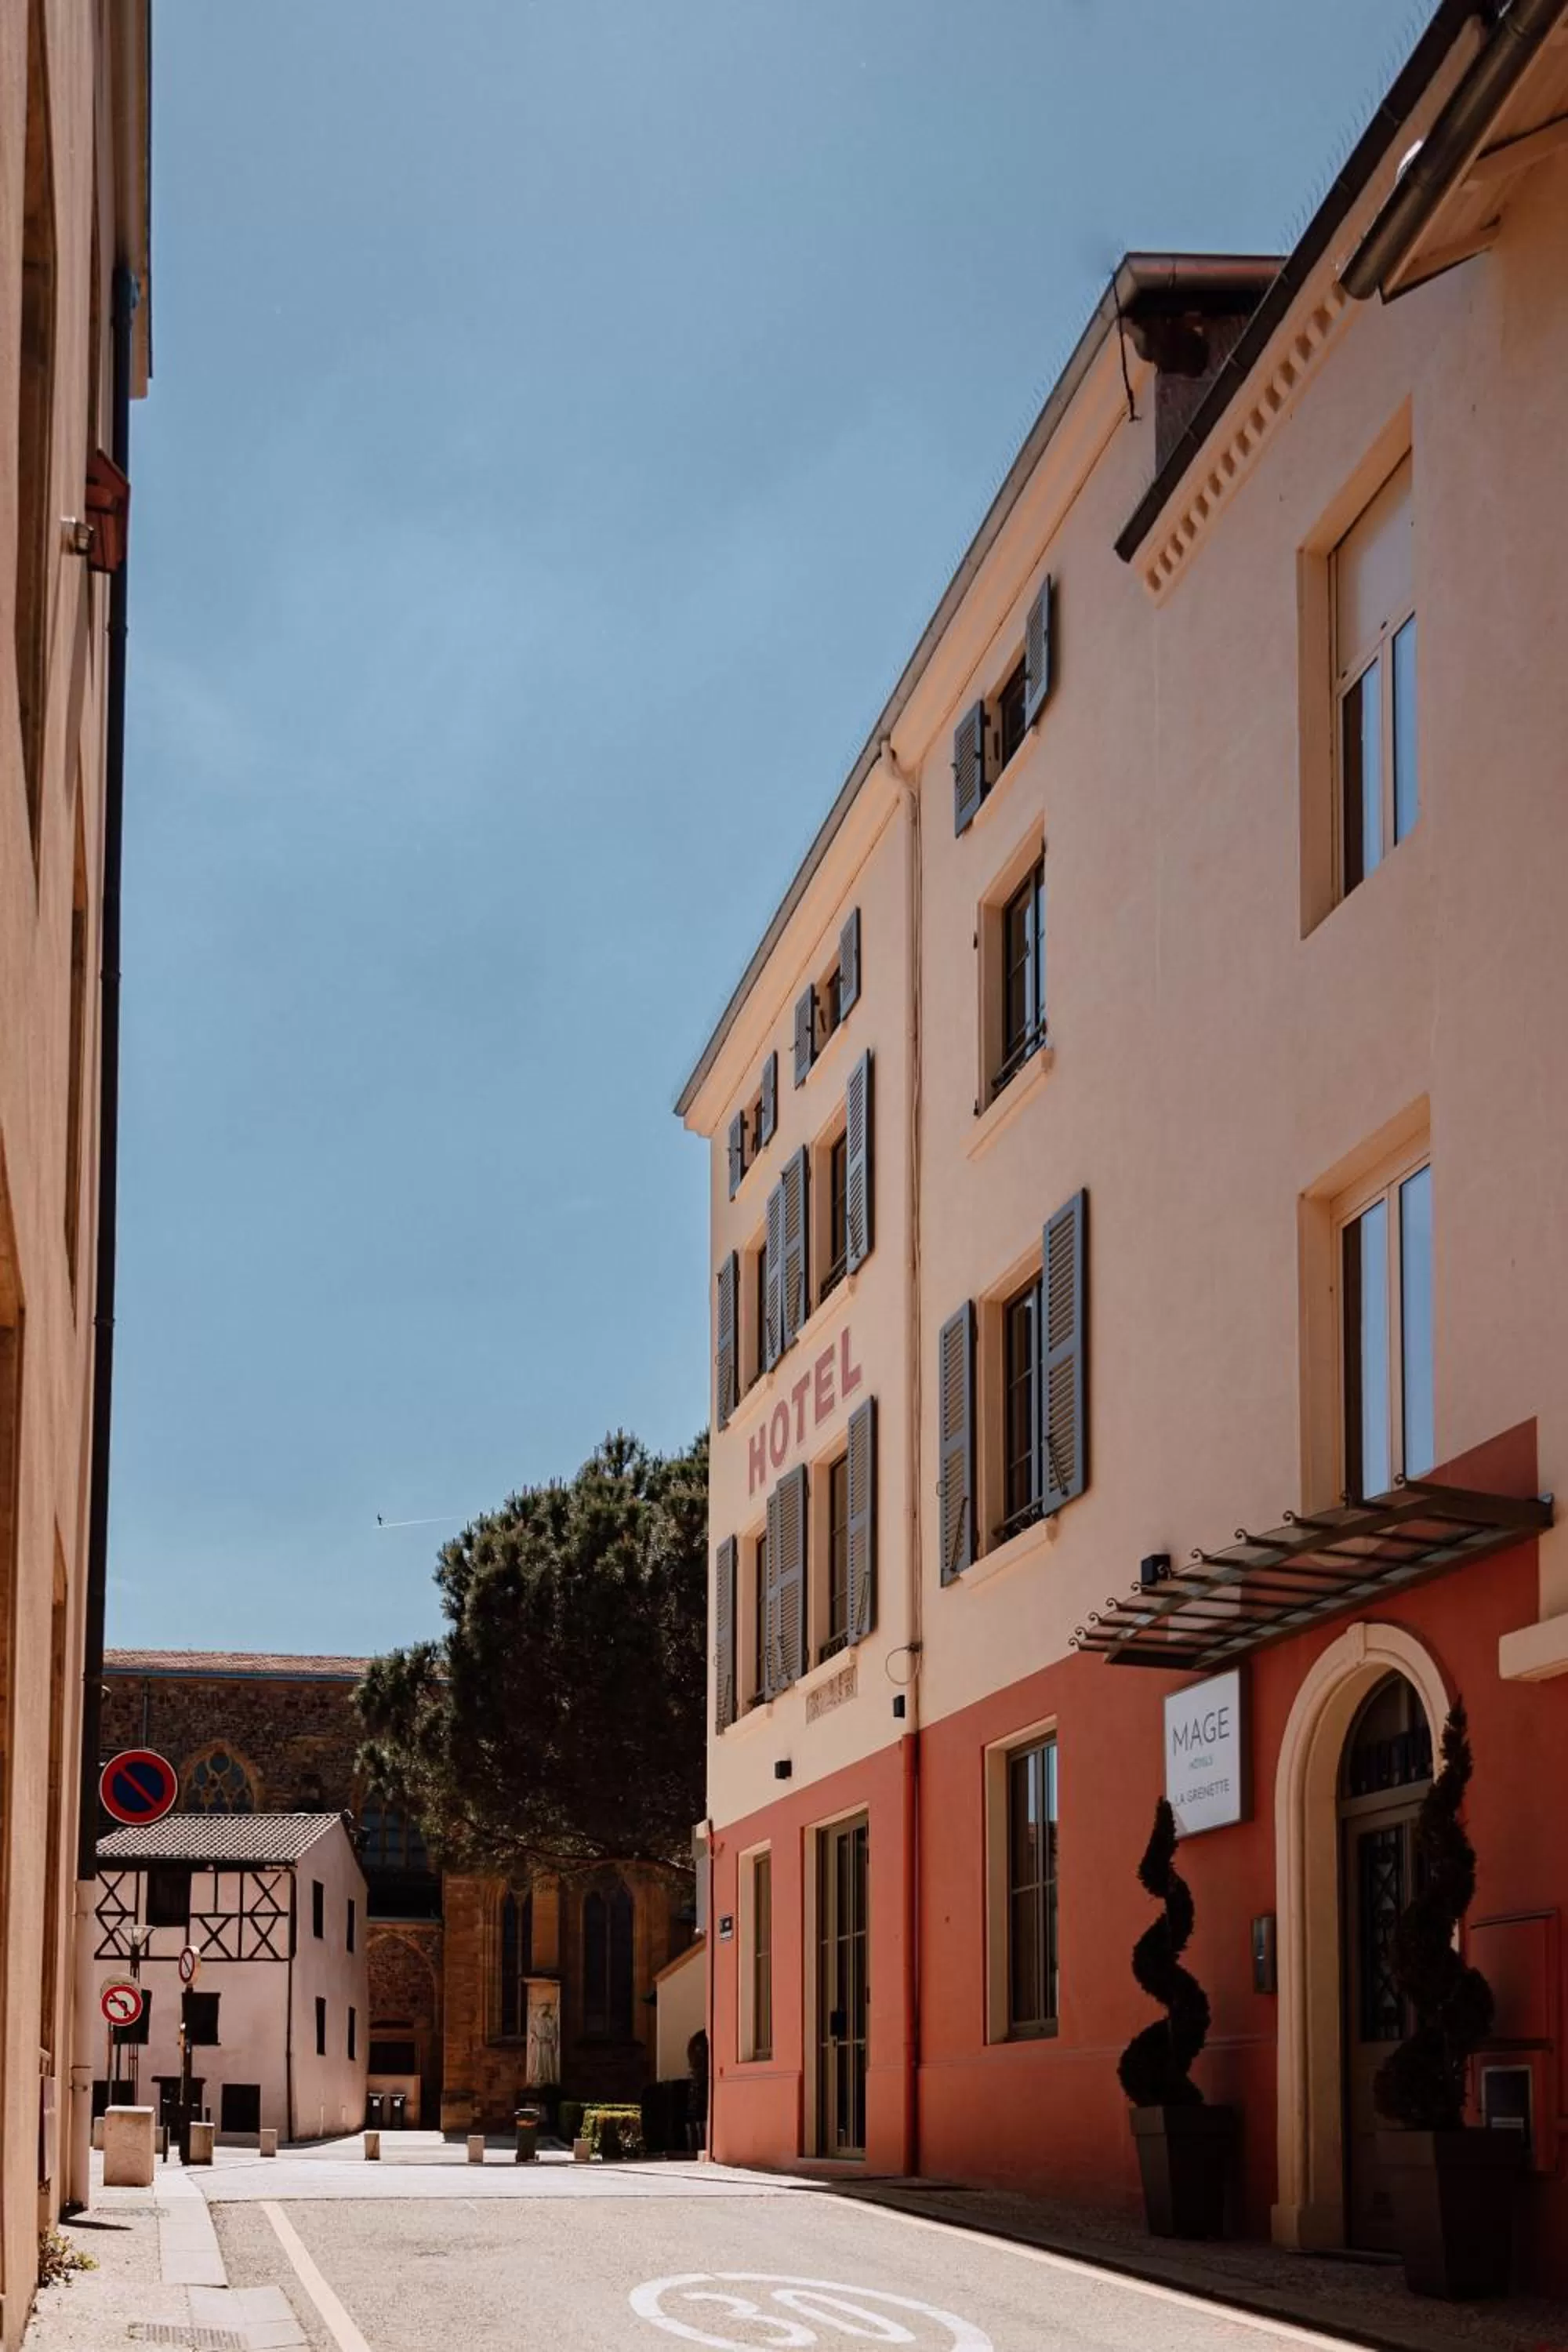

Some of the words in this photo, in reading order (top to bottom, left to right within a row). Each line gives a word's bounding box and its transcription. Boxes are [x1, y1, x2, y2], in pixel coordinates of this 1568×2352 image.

[750, 1326, 862, 1496] HOTEL
[1173, 1707, 1230, 1756] MAGE
[683, 2289, 916, 2347] 30
